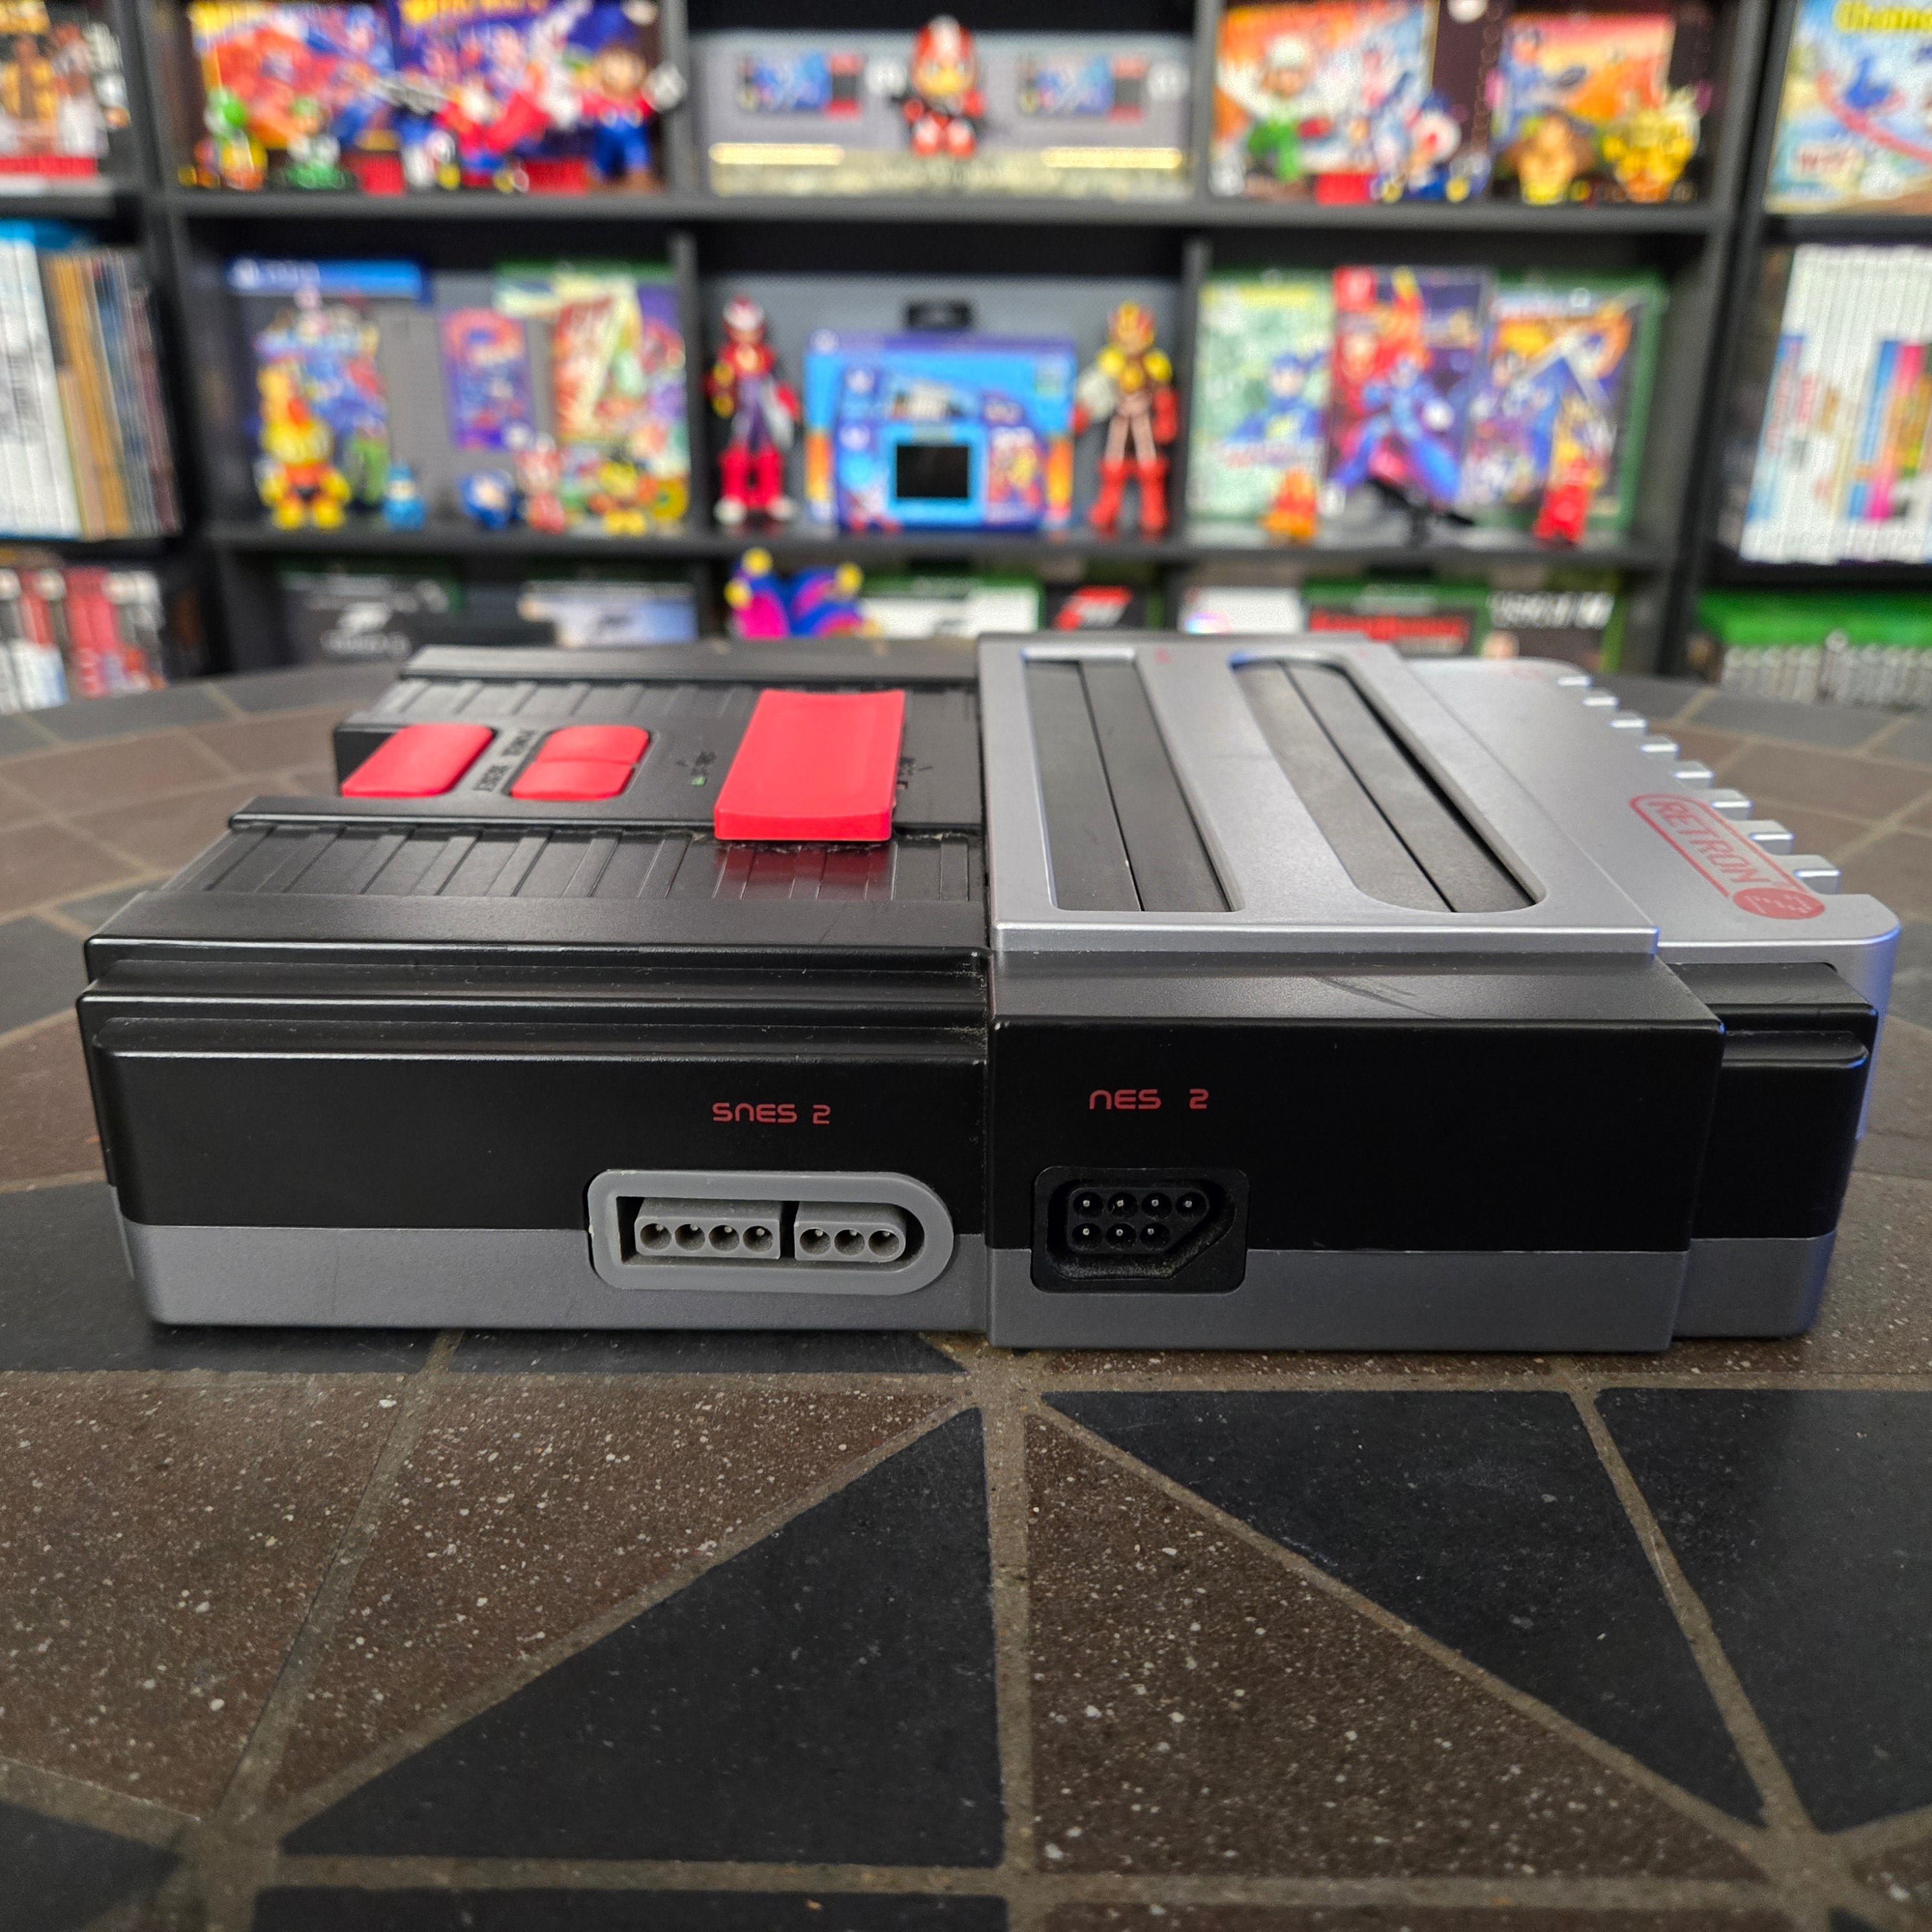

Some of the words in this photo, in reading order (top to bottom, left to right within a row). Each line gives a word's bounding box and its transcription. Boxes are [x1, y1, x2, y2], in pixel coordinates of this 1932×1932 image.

[1648, 801, 1771, 883] RETRON
[1089, 1089, 1162, 1110] NES
[1189, 1088, 1209, 1109] 2
[712, 1102, 798, 1124] SNES
[812, 1104, 831, 1124] 2
